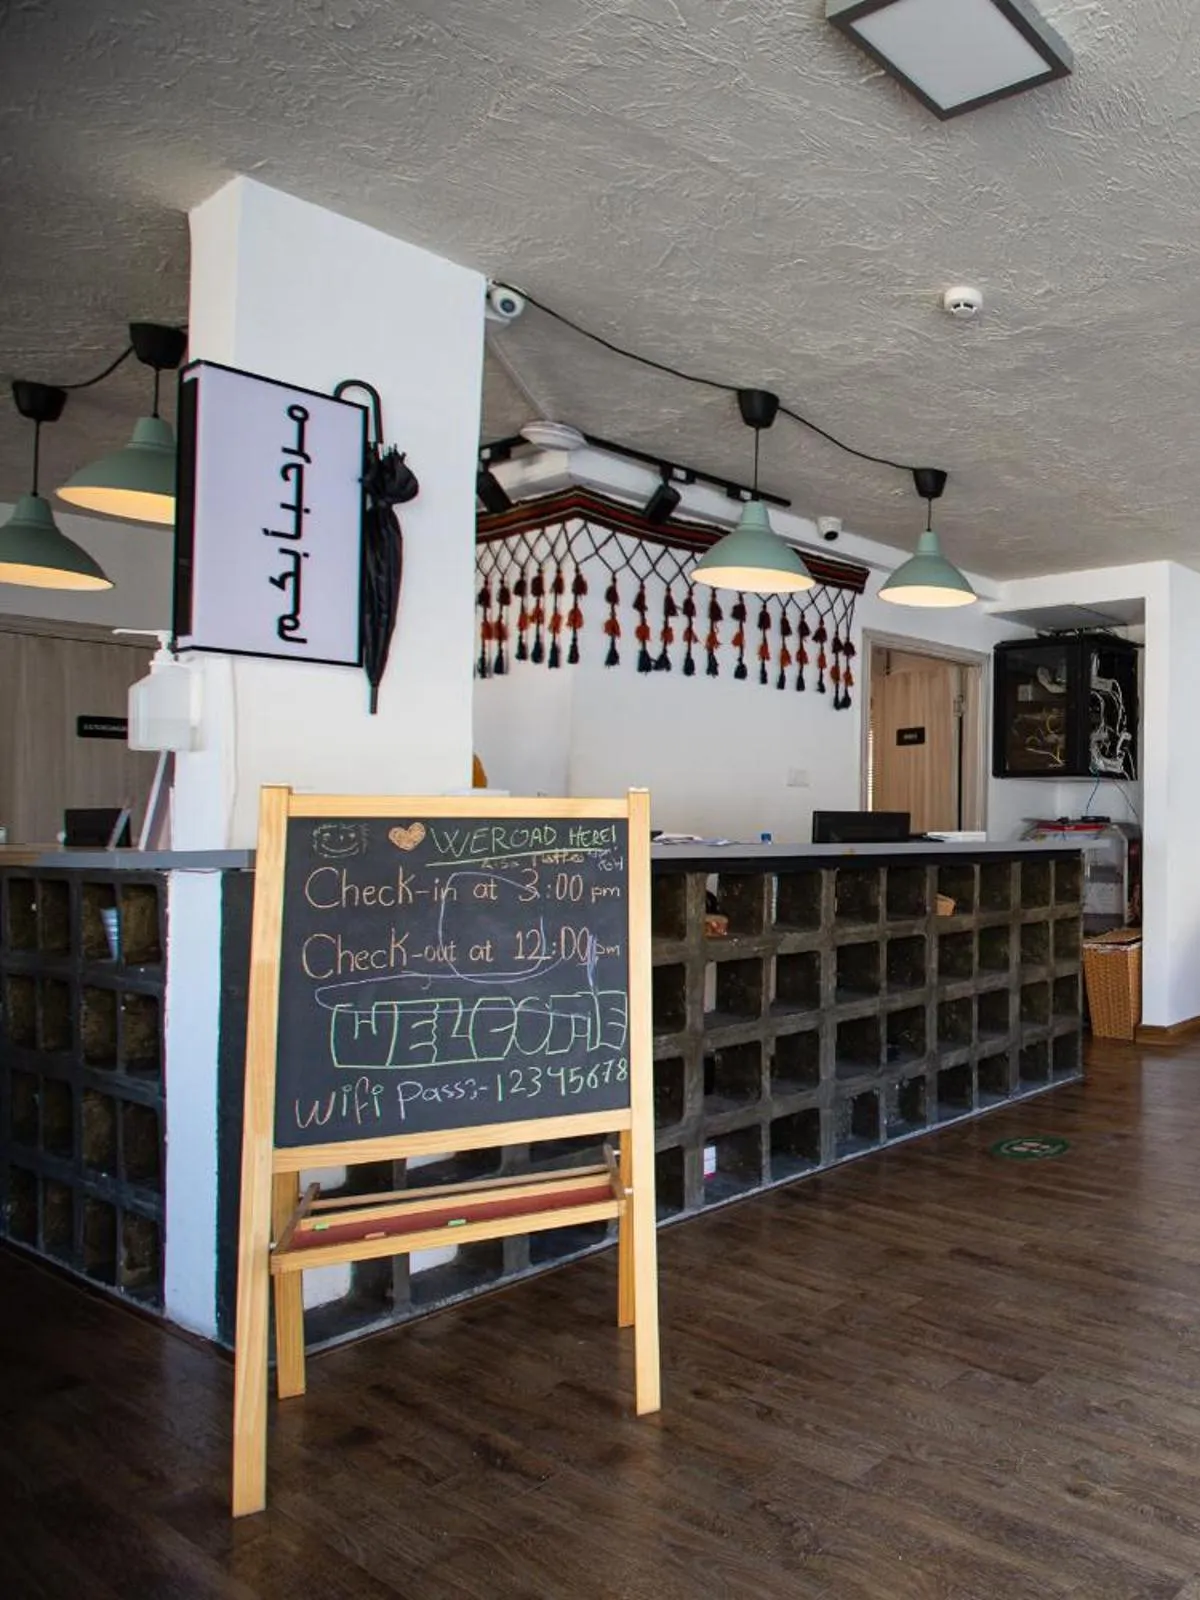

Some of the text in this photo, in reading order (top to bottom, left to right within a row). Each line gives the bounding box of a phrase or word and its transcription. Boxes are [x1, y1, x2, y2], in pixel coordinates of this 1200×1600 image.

[269, 547, 310, 644] بكم
[430, 824, 617, 857] WEROAD HERE!
[305, 866, 621, 908] Check-in at 3:00 pm
[302, 927, 457, 979] Check-out
[469, 939, 494, 963] at
[496, 1057, 628, 1102] 12345678
